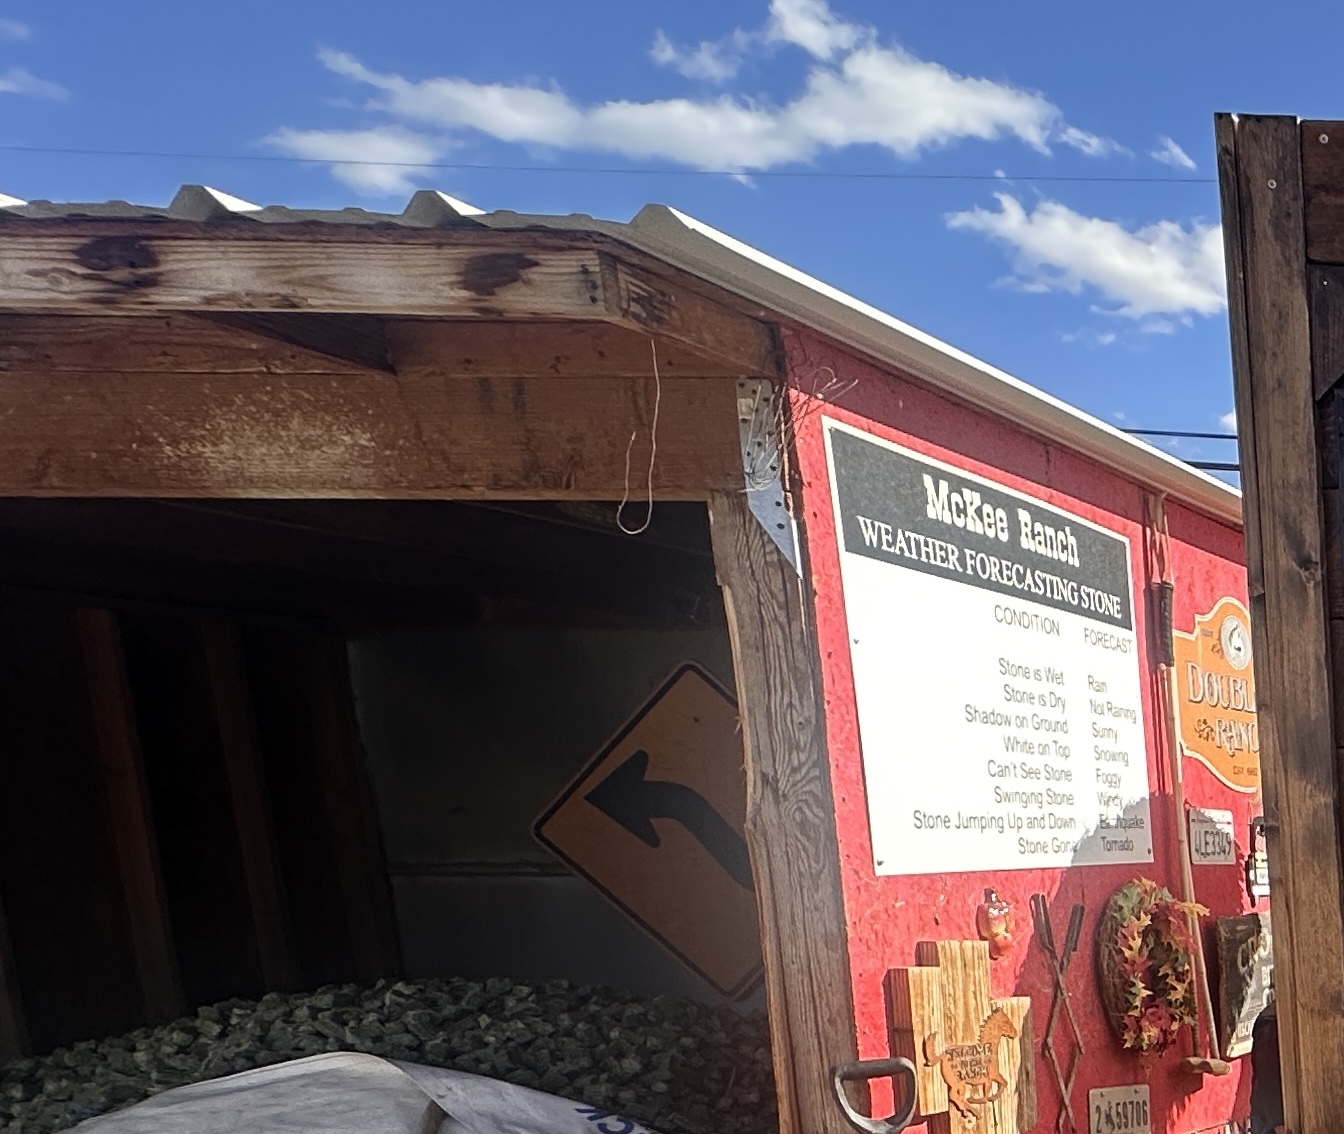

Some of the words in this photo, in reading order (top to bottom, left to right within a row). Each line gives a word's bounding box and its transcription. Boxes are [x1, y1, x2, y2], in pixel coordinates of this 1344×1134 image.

[922, 474, 1009, 542] McKee
[1018, 508, 1080, 567] Ranch
[856, 515, 963, 573] WEATHER
[964, 548, 1079, 606] FORECASTING
[1080, 585, 1122, 619] STONE
[994, 604, 1060, 636] CONDITION
[1083, 627, 1133, 653] FORECAST
[999, 657, 1030, 680] Stone
[1033, 668, 1042, 682] is
[1044, 666, 1064, 686] Wet
[1088, 675, 1107, 693] Rain
[1003, 684, 1035, 705] Stone
[1038, 693, 1046, 707] is
[1049, 691, 1066, 714] Dry
[1186, 661, 1257, 713] DOUBL
[965, 704, 1011, 727] Shadow
[1015, 715, 1029, 729] on
[1031, 713, 1068, 734] Ground
[1089, 699, 1105, 716] Not
[1106, 701, 1136, 724] Raining
[1092, 722, 1118, 744] Sunny
[1215, 718, 1259, 757] RANC
[1003, 735, 1035, 755] White
[1038, 742, 1050, 755] on
[1052, 740, 1070, 761] Top
[1094, 745, 1129, 767] Snowing
[987, 759, 1018, 778] Can't
[1020, 762, 1041, 780] See
[1044, 763, 1072, 782] Stone
[1096, 768, 1121, 789] Foggy
[994, 786, 1043, 809] Swinging
[1046, 787, 1074, 806] Stone
[1097, 791, 1123, 810] Windy
[913, 810, 950, 830] Stone
[954, 810, 1004, 833] Jumping
[1007, 812, 1023, 833] Up
[1026, 813, 1045, 830] and
[1048, 812, 1076, 830] Down
[1018, 837, 1048, 855] Stone
[1101, 836, 1134, 852] Tornado
[1115, 1099, 1148, 1131] 59706
